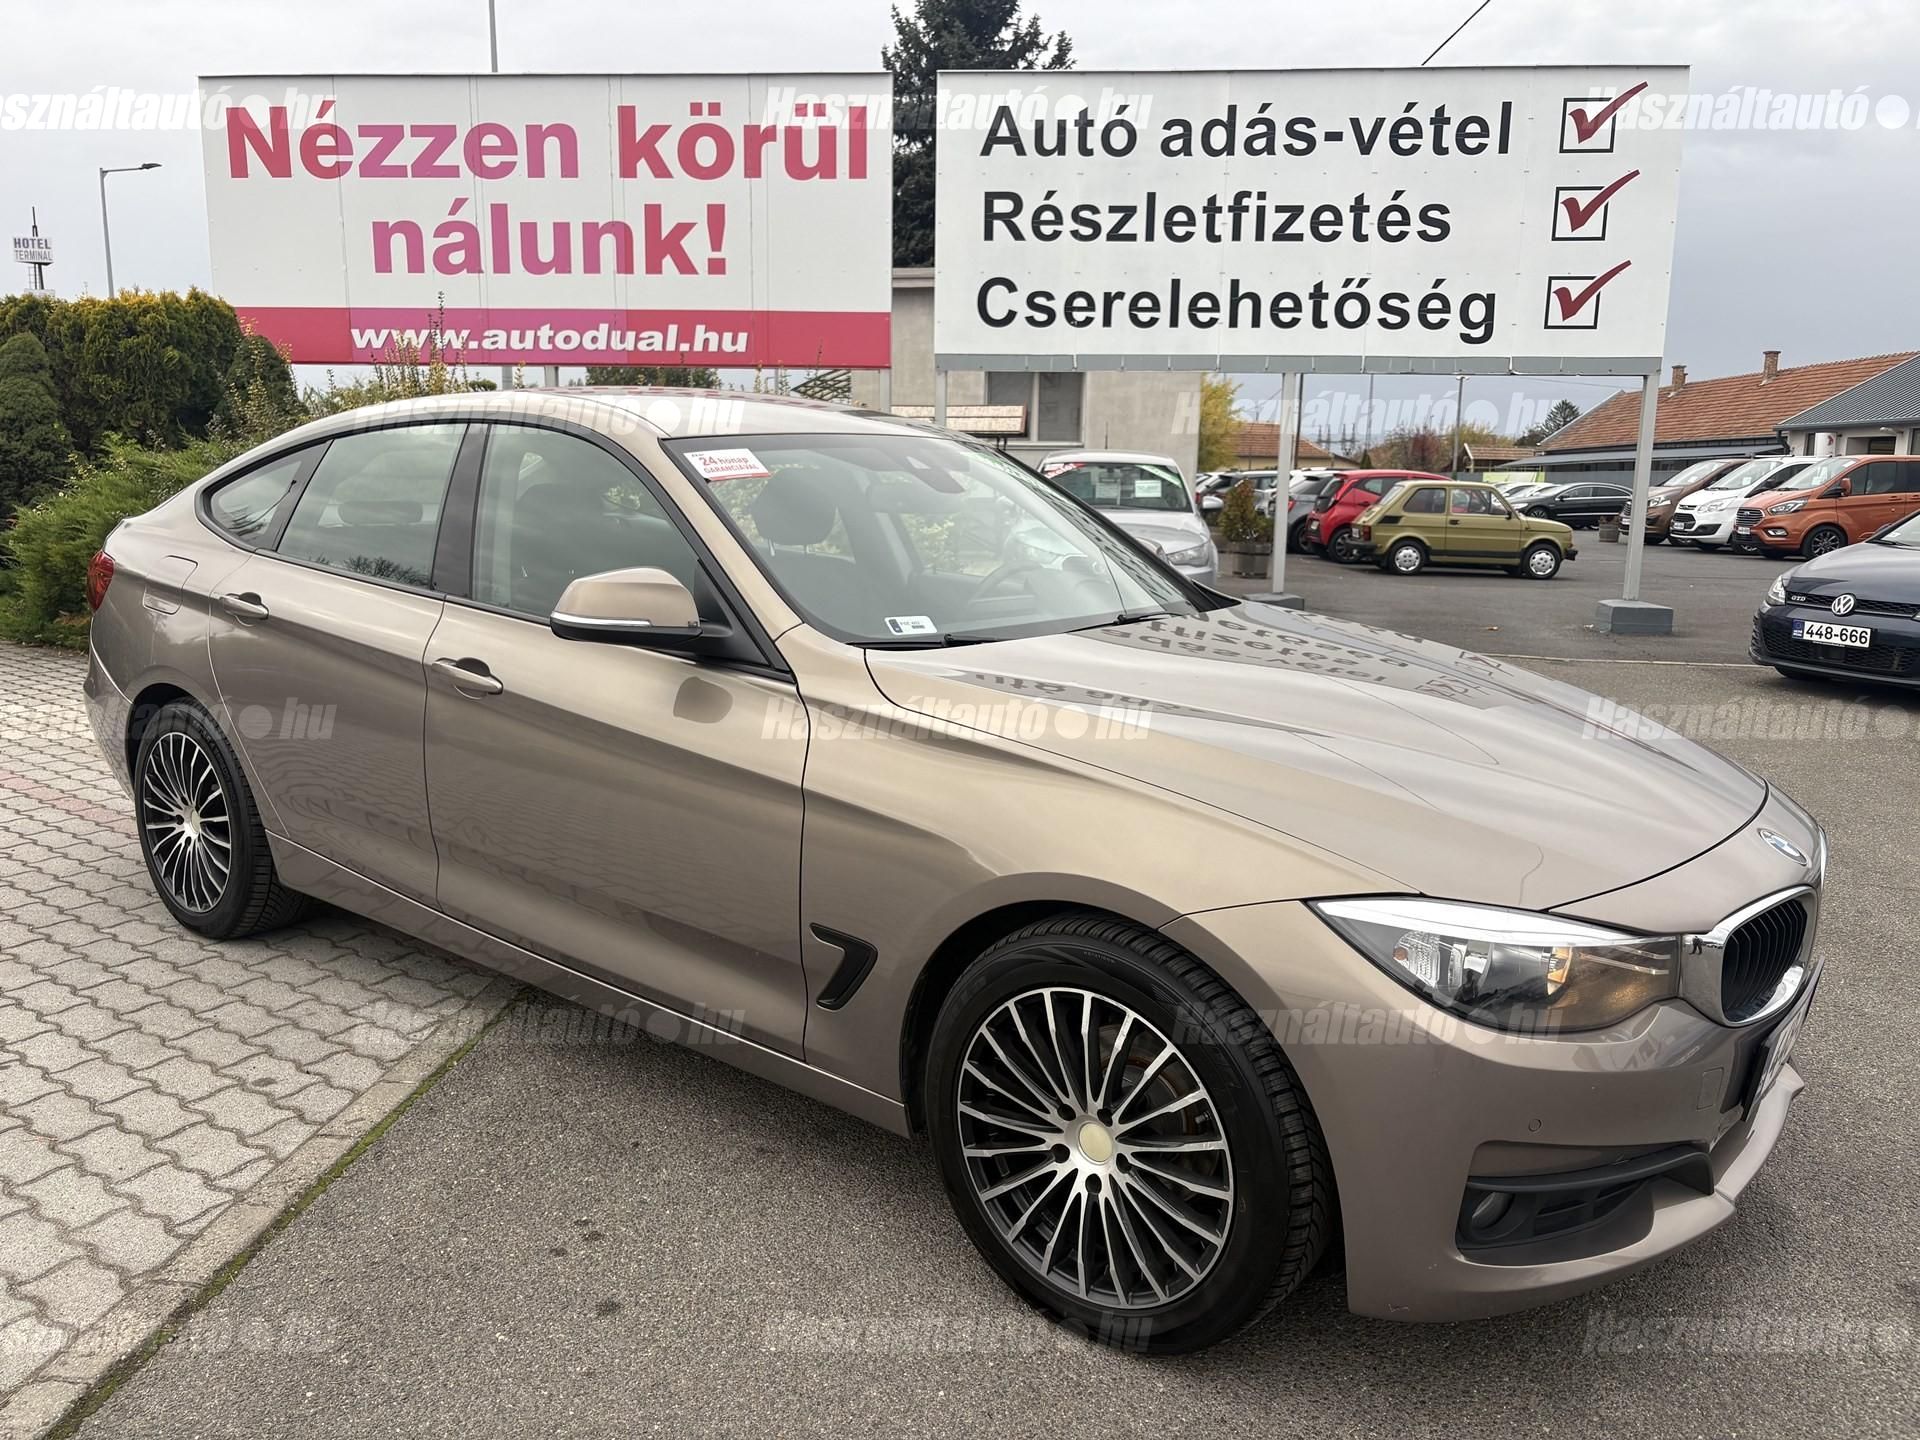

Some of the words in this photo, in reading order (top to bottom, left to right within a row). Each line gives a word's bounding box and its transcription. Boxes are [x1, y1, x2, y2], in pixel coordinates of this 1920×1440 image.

[225, 100, 579, 180] Nézzen
[618, 102, 868, 180] körül
[980, 105, 1138, 157] Autó
[1160, 101, 1513, 157] adás-vétel
[372, 197, 726, 275] nálunk!
[983, 190, 1452, 243] Részletfizetés
[14, 238, 51, 249] HOTEL
[15, 250, 53, 261] TERMINAL
[977, 277, 1496, 344] Cserelehetőség
[350, 323, 748, 353] www.autodual.hu
[699, 456, 717, 466] 24
[1806, 623, 1869, 645] 448-666
